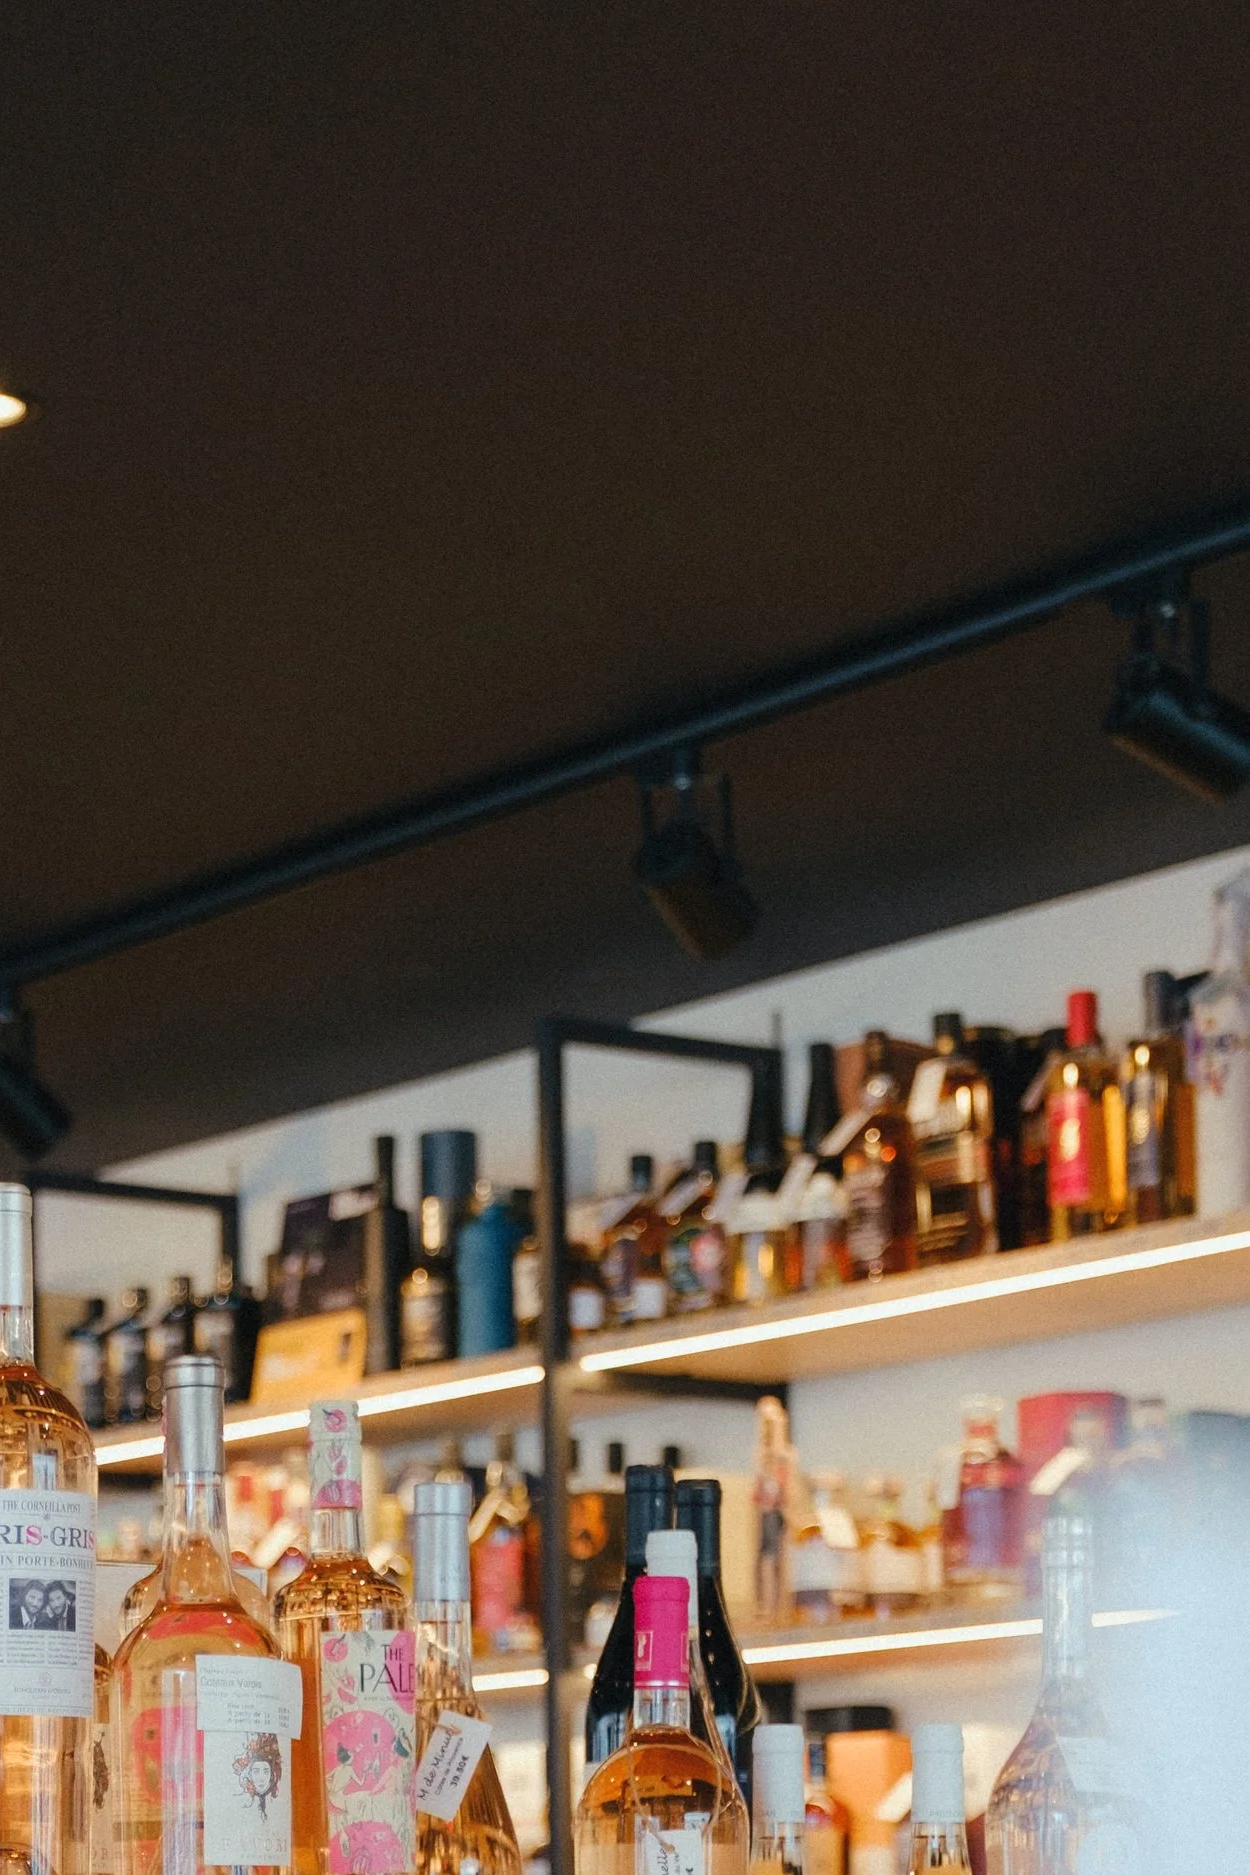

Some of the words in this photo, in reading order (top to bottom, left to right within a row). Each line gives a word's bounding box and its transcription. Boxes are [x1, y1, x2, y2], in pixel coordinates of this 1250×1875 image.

[2, 1500, 19, 1511] THE
[21, 1500, 66, 1513] CORNEILLA
[381, 1644, 403, 1661] THE
[417, 1788, 431, 1800] M
[424, 1769, 437, 1787] de
